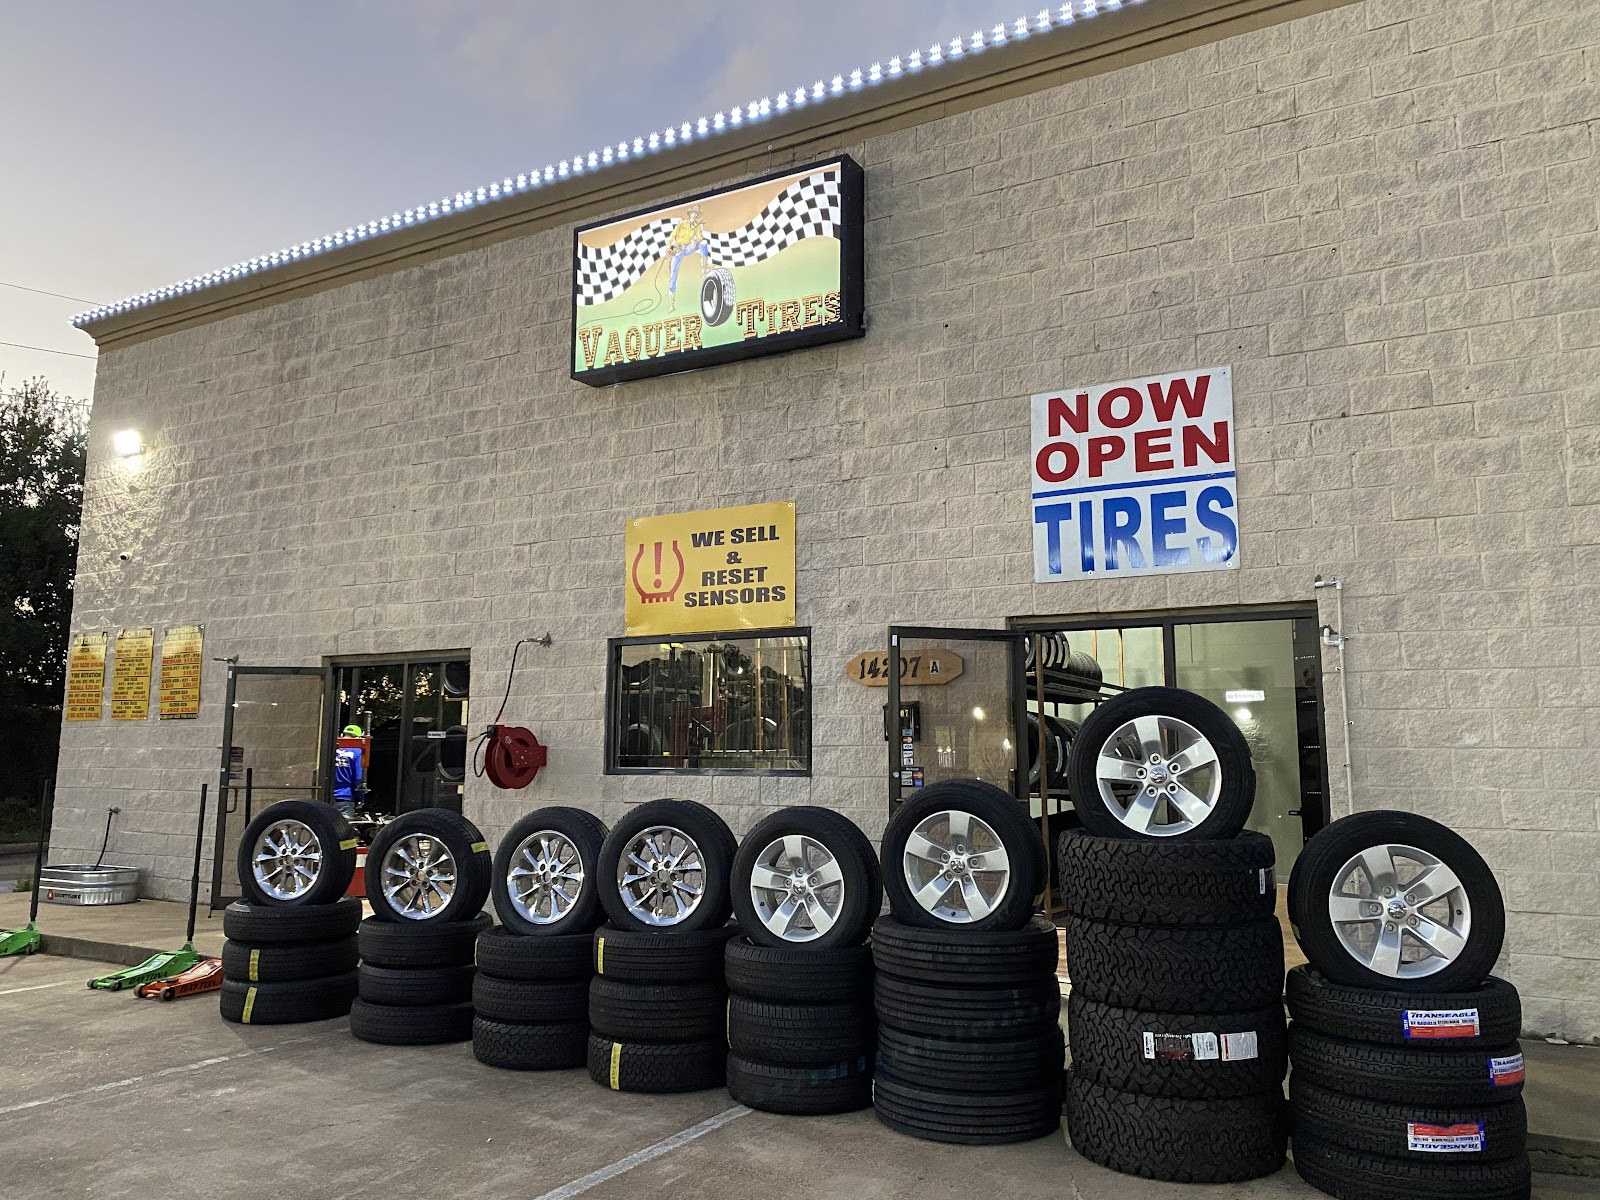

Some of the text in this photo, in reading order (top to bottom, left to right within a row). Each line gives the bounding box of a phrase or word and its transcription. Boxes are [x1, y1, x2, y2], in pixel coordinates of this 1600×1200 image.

[736, 292, 841, 340] TIRES
[1048, 375, 1211, 437] NOW
[1036, 421, 1230, 482] OPEN
[691, 525, 780, 548] WE SELL
[1035, 486, 1237, 574] TIRES
[726, 551, 742, 564] &
[701, 566, 768, 586] RESET
[684, 586, 786, 607] SENSORS
[168, 626, 199, 634] PATCHES
[931, 661, 939, 673] A
[129, 971, 168, 985] DAYTONA
[1410, 1011, 1476, 1019] TRANSEAGLE
